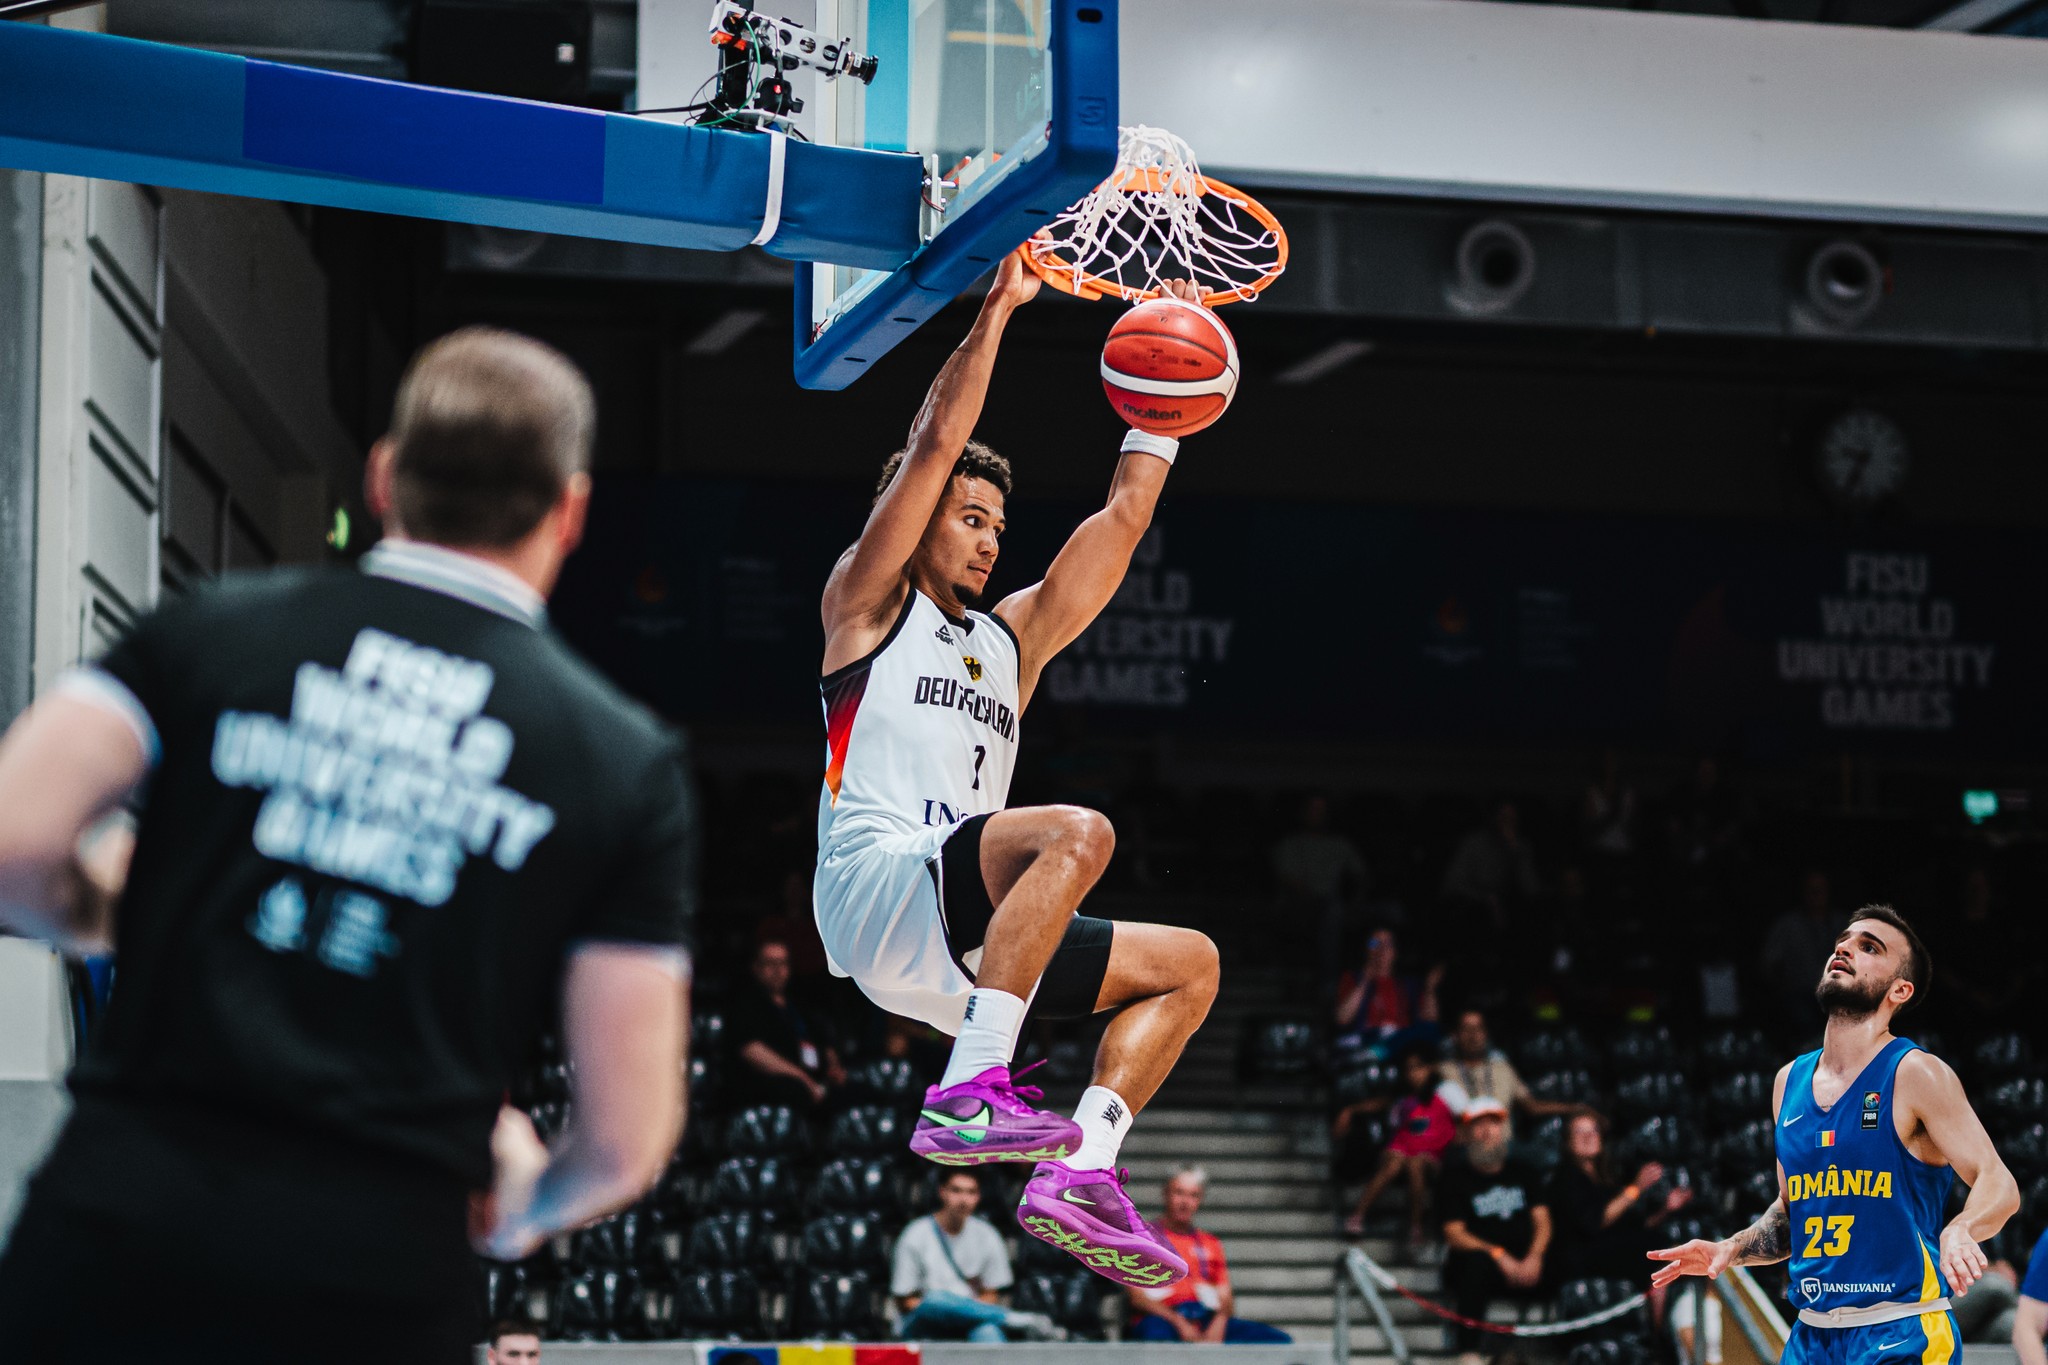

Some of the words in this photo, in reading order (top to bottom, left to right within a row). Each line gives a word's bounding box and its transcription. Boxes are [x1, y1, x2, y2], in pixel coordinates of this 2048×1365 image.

[1123, 403, 1182, 420] molten
[1846, 552, 1929, 595] FISU
[1818, 595, 1954, 639] WORLD
[1776, 639, 1995, 687] UNIVERSITY
[914, 676, 1016, 743] DEUTSCHLAN
[1821, 687, 1954, 729] GAMES
[922, 798, 969, 827] IN
[1863, 1112, 1877, 1121] FIBA
[1787, 1163, 1893, 1201] OMÂNIA
[1802, 1214, 1855, 1259] 23
[1804, 1283, 1818, 1293] BT
